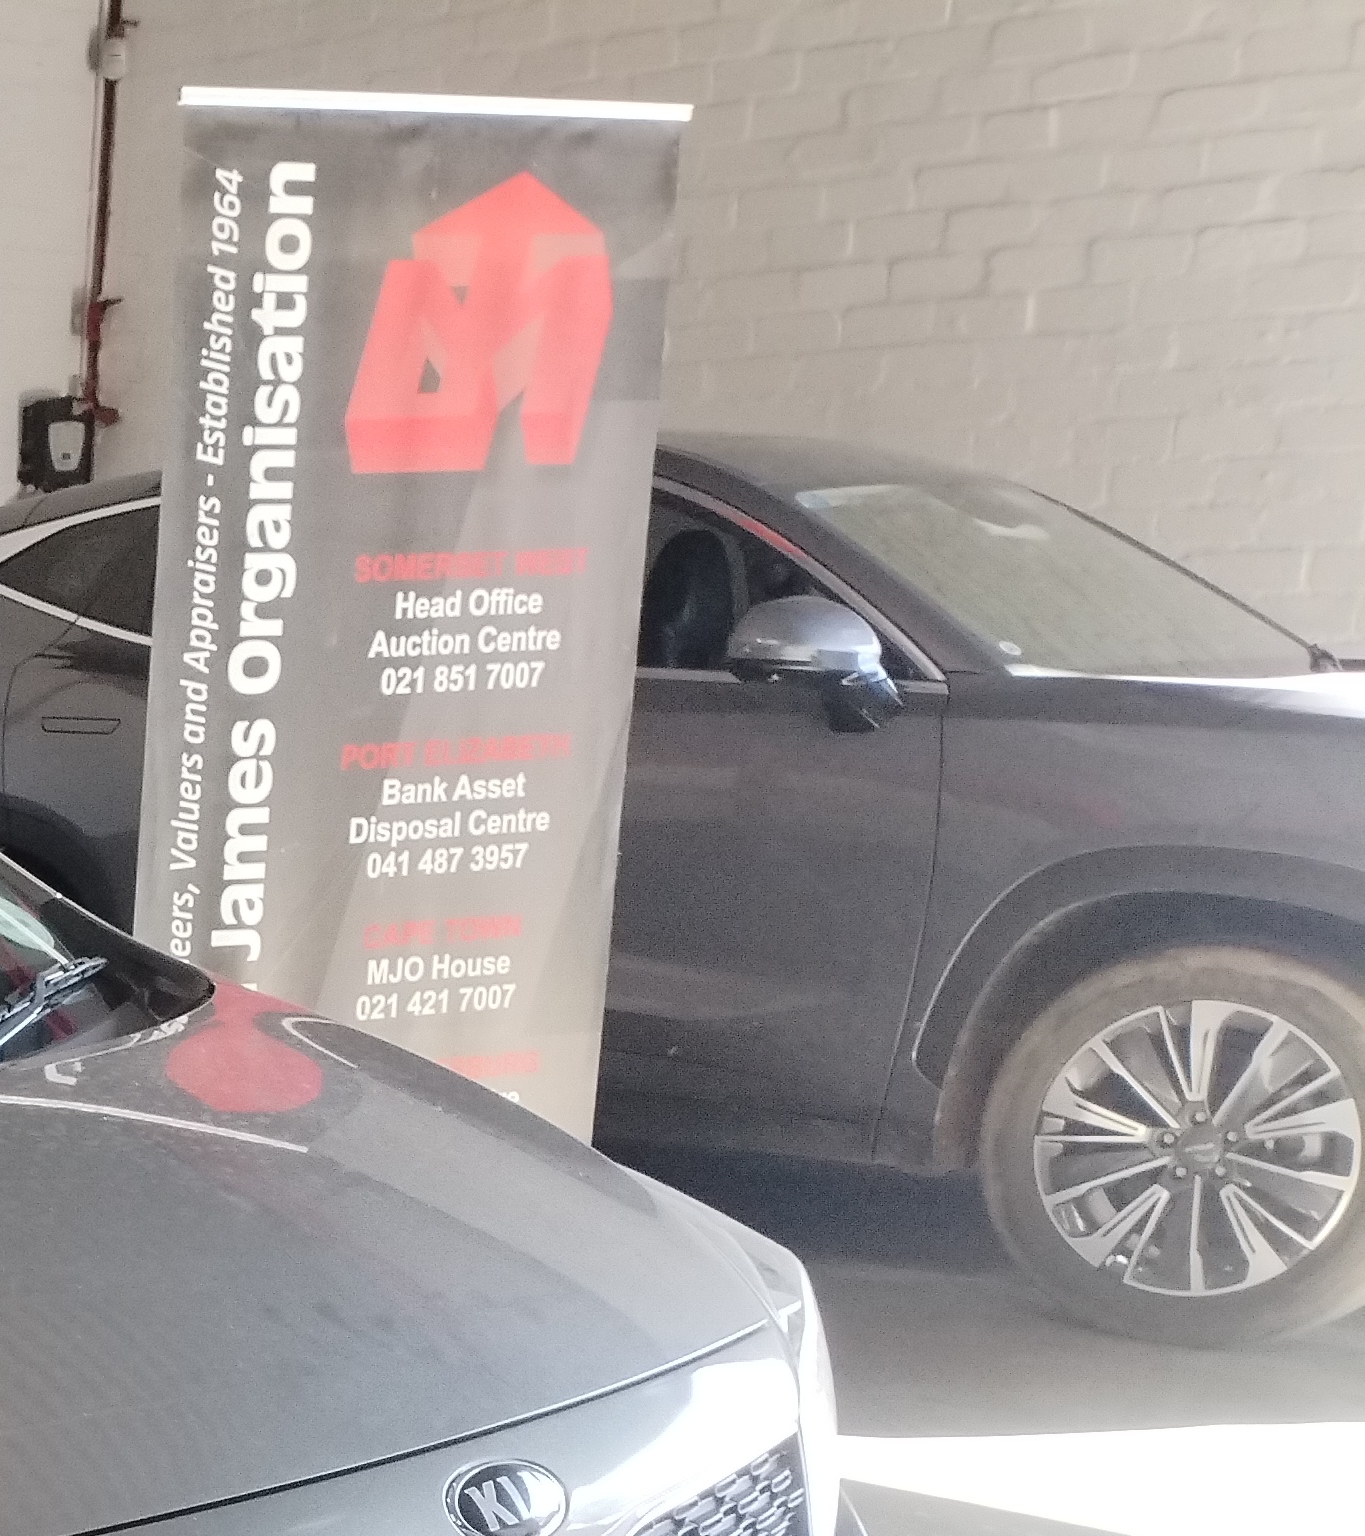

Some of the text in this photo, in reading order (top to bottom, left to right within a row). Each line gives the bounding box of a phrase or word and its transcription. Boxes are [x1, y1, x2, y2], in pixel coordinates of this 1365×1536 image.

[211, 167, 243, 257] 1964
[195, 264, 237, 466] Established
[210, 161, 317, 962] James Organisation
[356, 547, 590, 583] SOMERSET WEST
[183, 494, 221, 674] Appraisers
[395, 587, 544, 620] Head Office
[367, 625, 561, 659] Auction Centre
[381, 660, 546, 696] 021 851 7007
[179, 679, 208, 745] and
[340, 741, 418, 771] PORT
[381, 771, 526, 806] Bank Asset
[169, 751, 204, 870] Valuers
[349, 807, 551, 848] Disposal Centre
[367, 842, 530, 879] 041 487 3957
[170, 883, 201, 963] eers,
[367, 953, 511, 986] MJO House
[355, 983, 517, 1021] 021 421 7007
